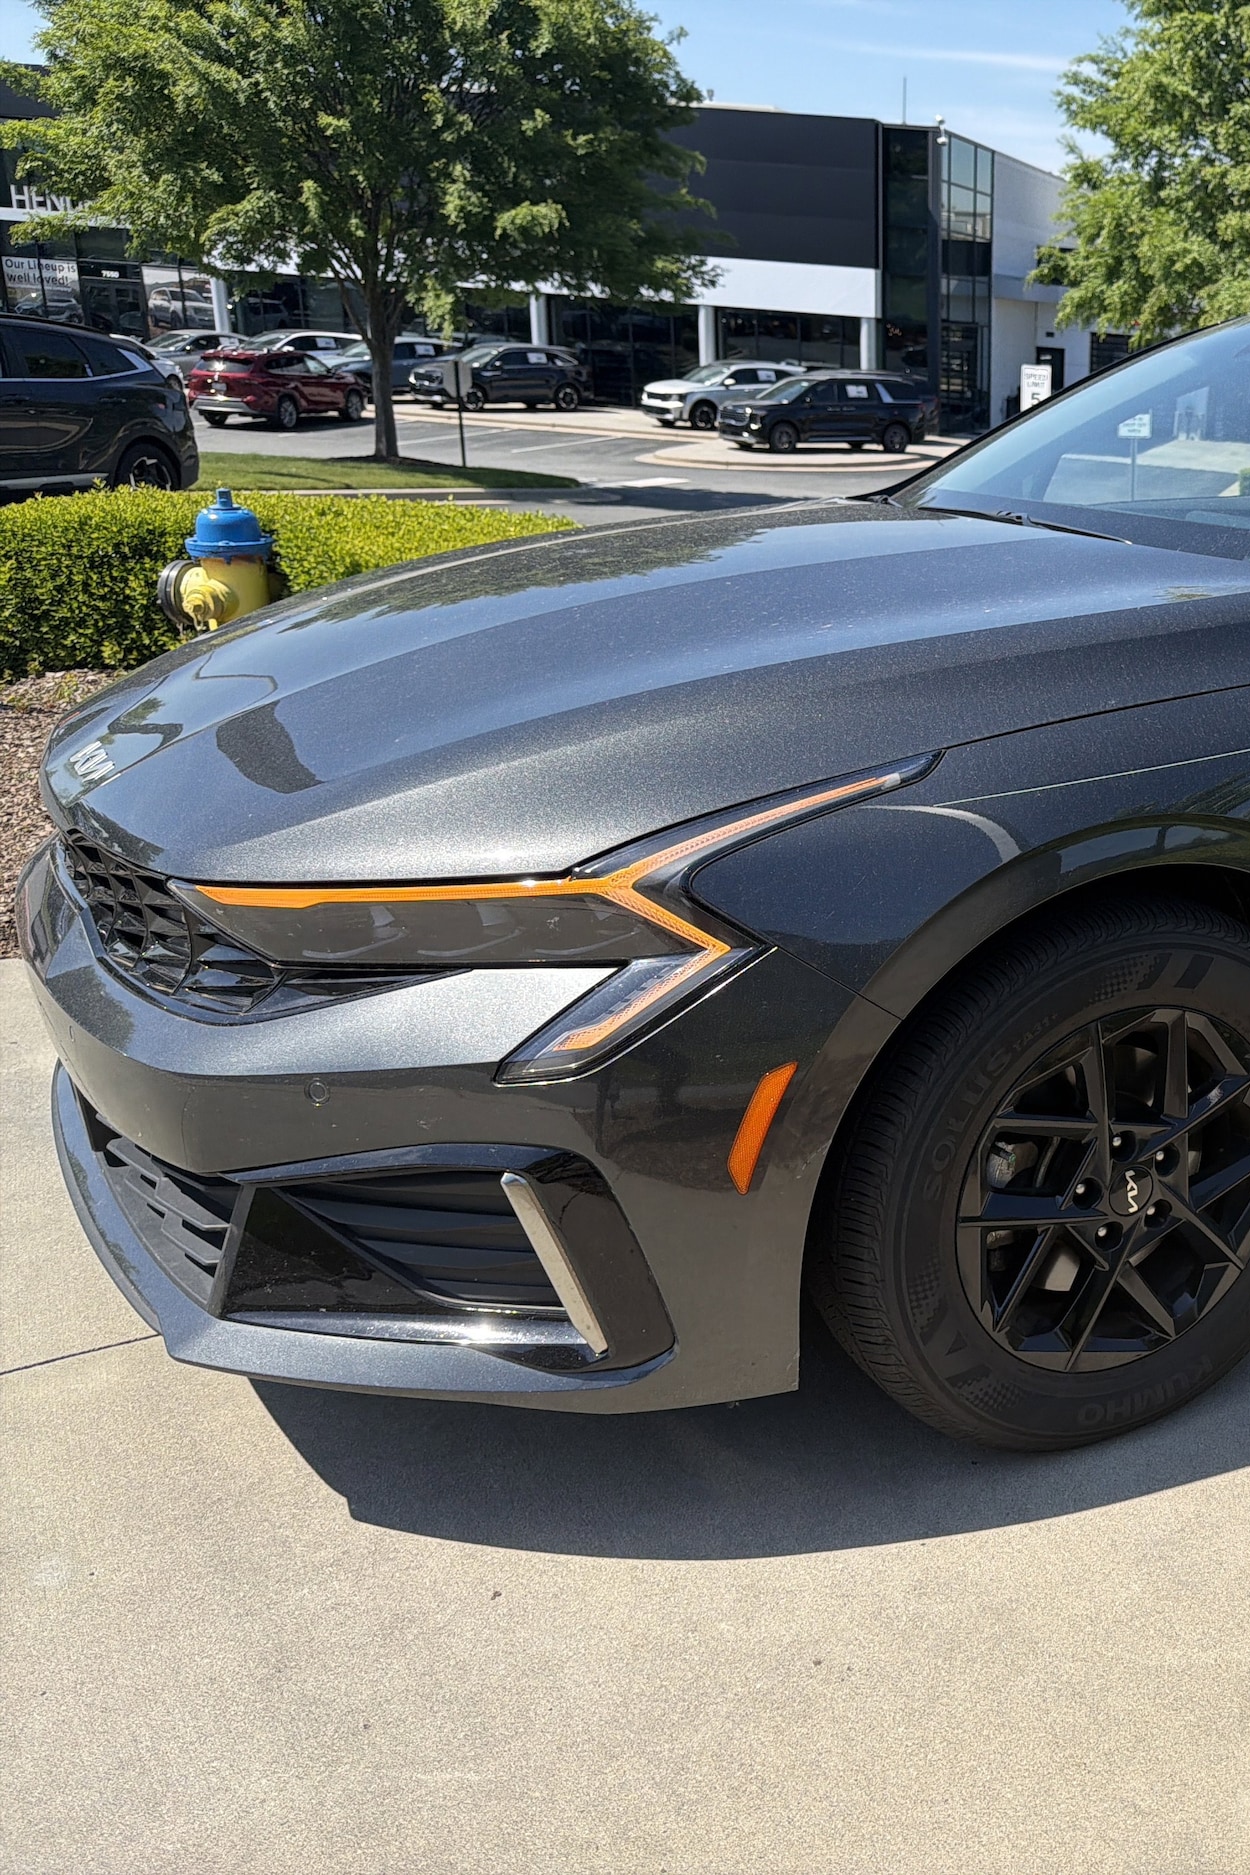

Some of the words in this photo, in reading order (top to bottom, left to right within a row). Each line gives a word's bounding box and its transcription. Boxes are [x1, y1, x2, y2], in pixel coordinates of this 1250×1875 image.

[5, 258, 24, 269] Our
[67, 262, 76, 273] is
[6, 272, 30, 283] well
[923, 1050, 1013, 1201] SOLUS
[1078, 1353, 1214, 1426] KUMHO
